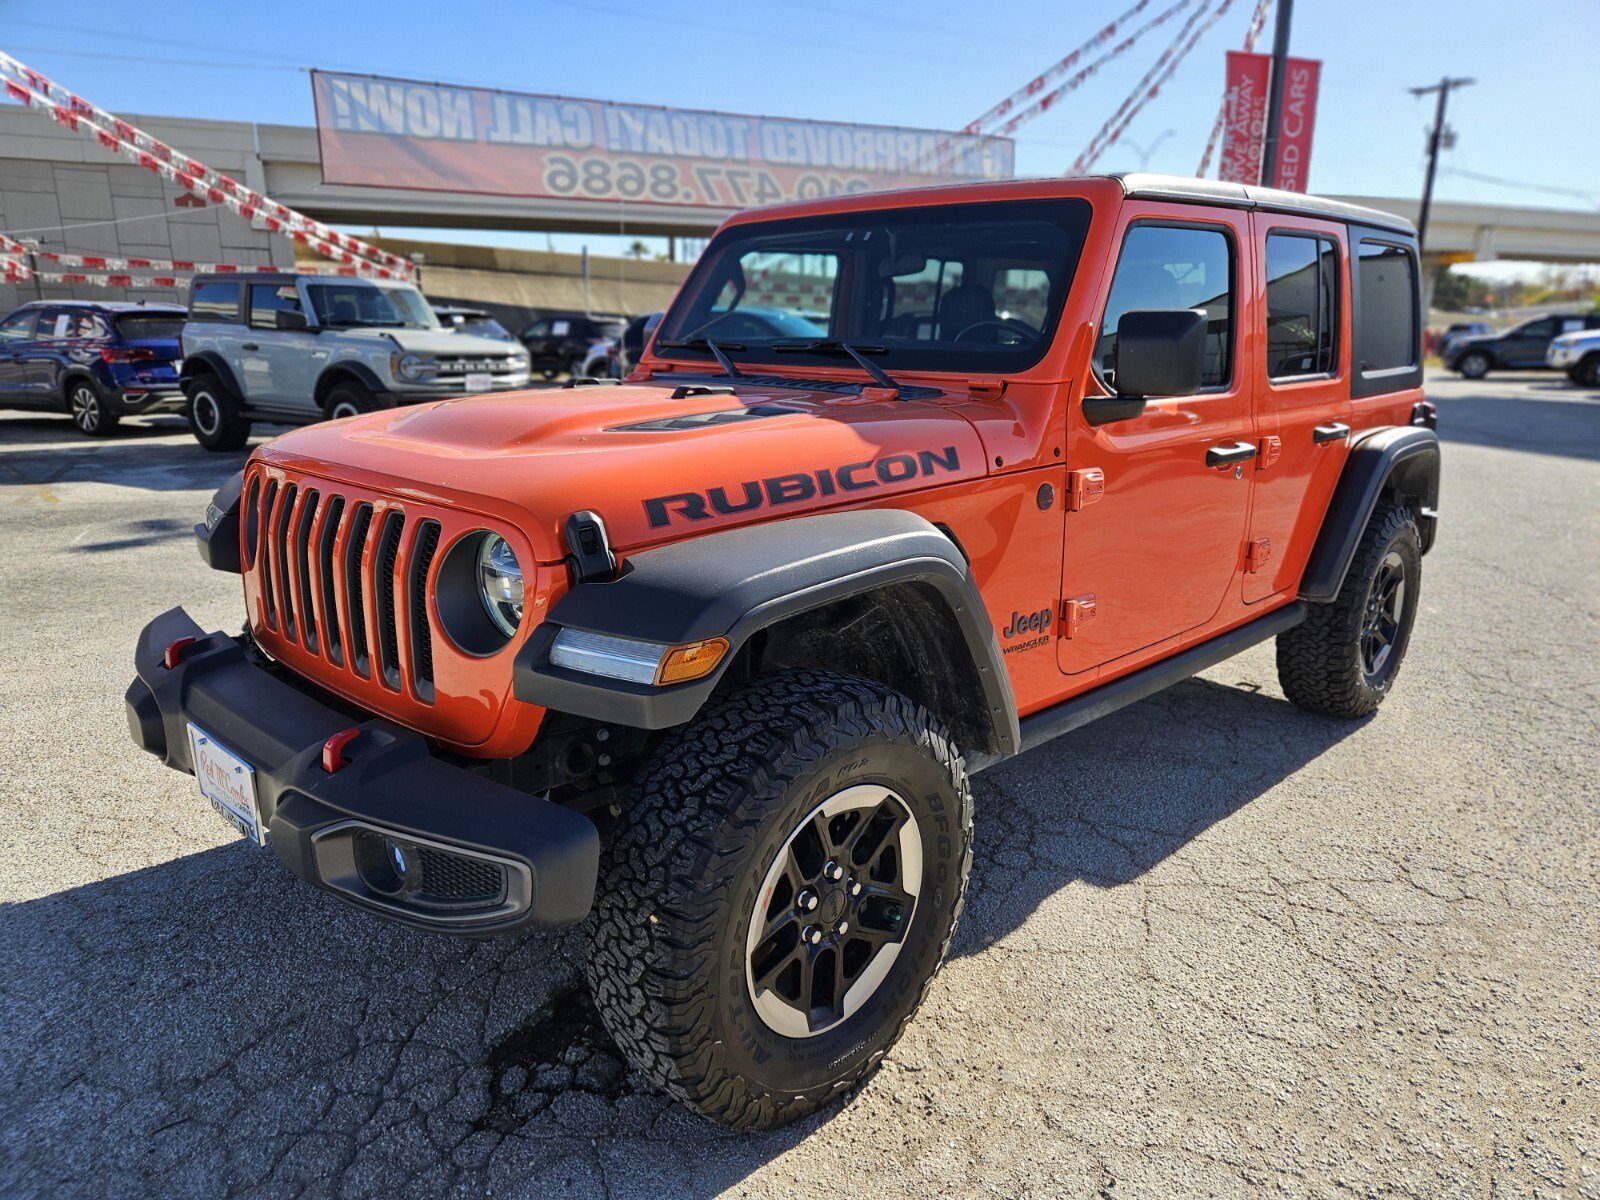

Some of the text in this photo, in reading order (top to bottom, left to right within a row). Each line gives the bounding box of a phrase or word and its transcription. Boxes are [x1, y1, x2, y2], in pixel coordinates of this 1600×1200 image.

[1279, 68, 1309, 191] SED CARS
[641, 446, 961, 529] RUBICON
[1002, 635, 1050, 655] WRANGLER
[1003, 608, 1053, 639] Jeep
